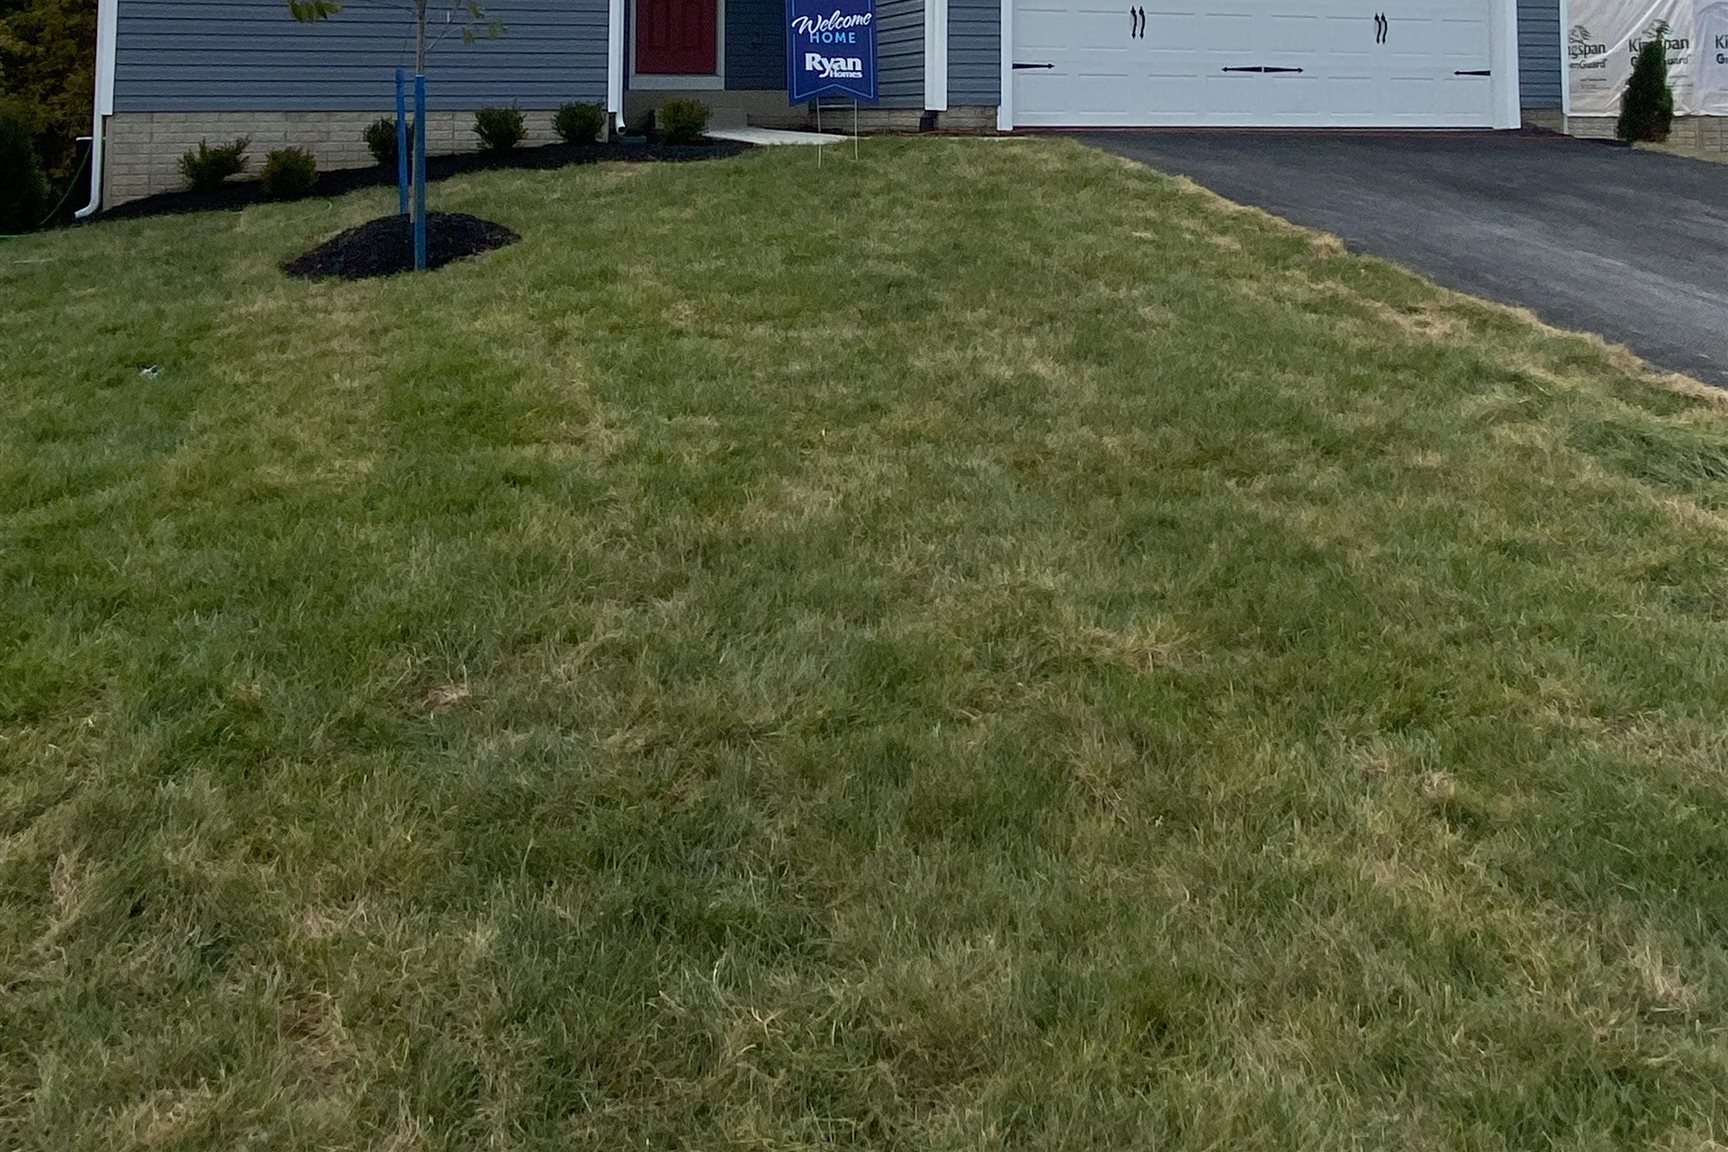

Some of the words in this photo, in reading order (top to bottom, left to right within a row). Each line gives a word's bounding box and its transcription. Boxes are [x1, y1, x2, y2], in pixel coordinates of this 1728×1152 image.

[791, 9, 872, 35] Welcome
[809, 32, 857, 44] HOME
[805, 52, 862, 78] Ryan
[829, 69, 863, 78] Homes
